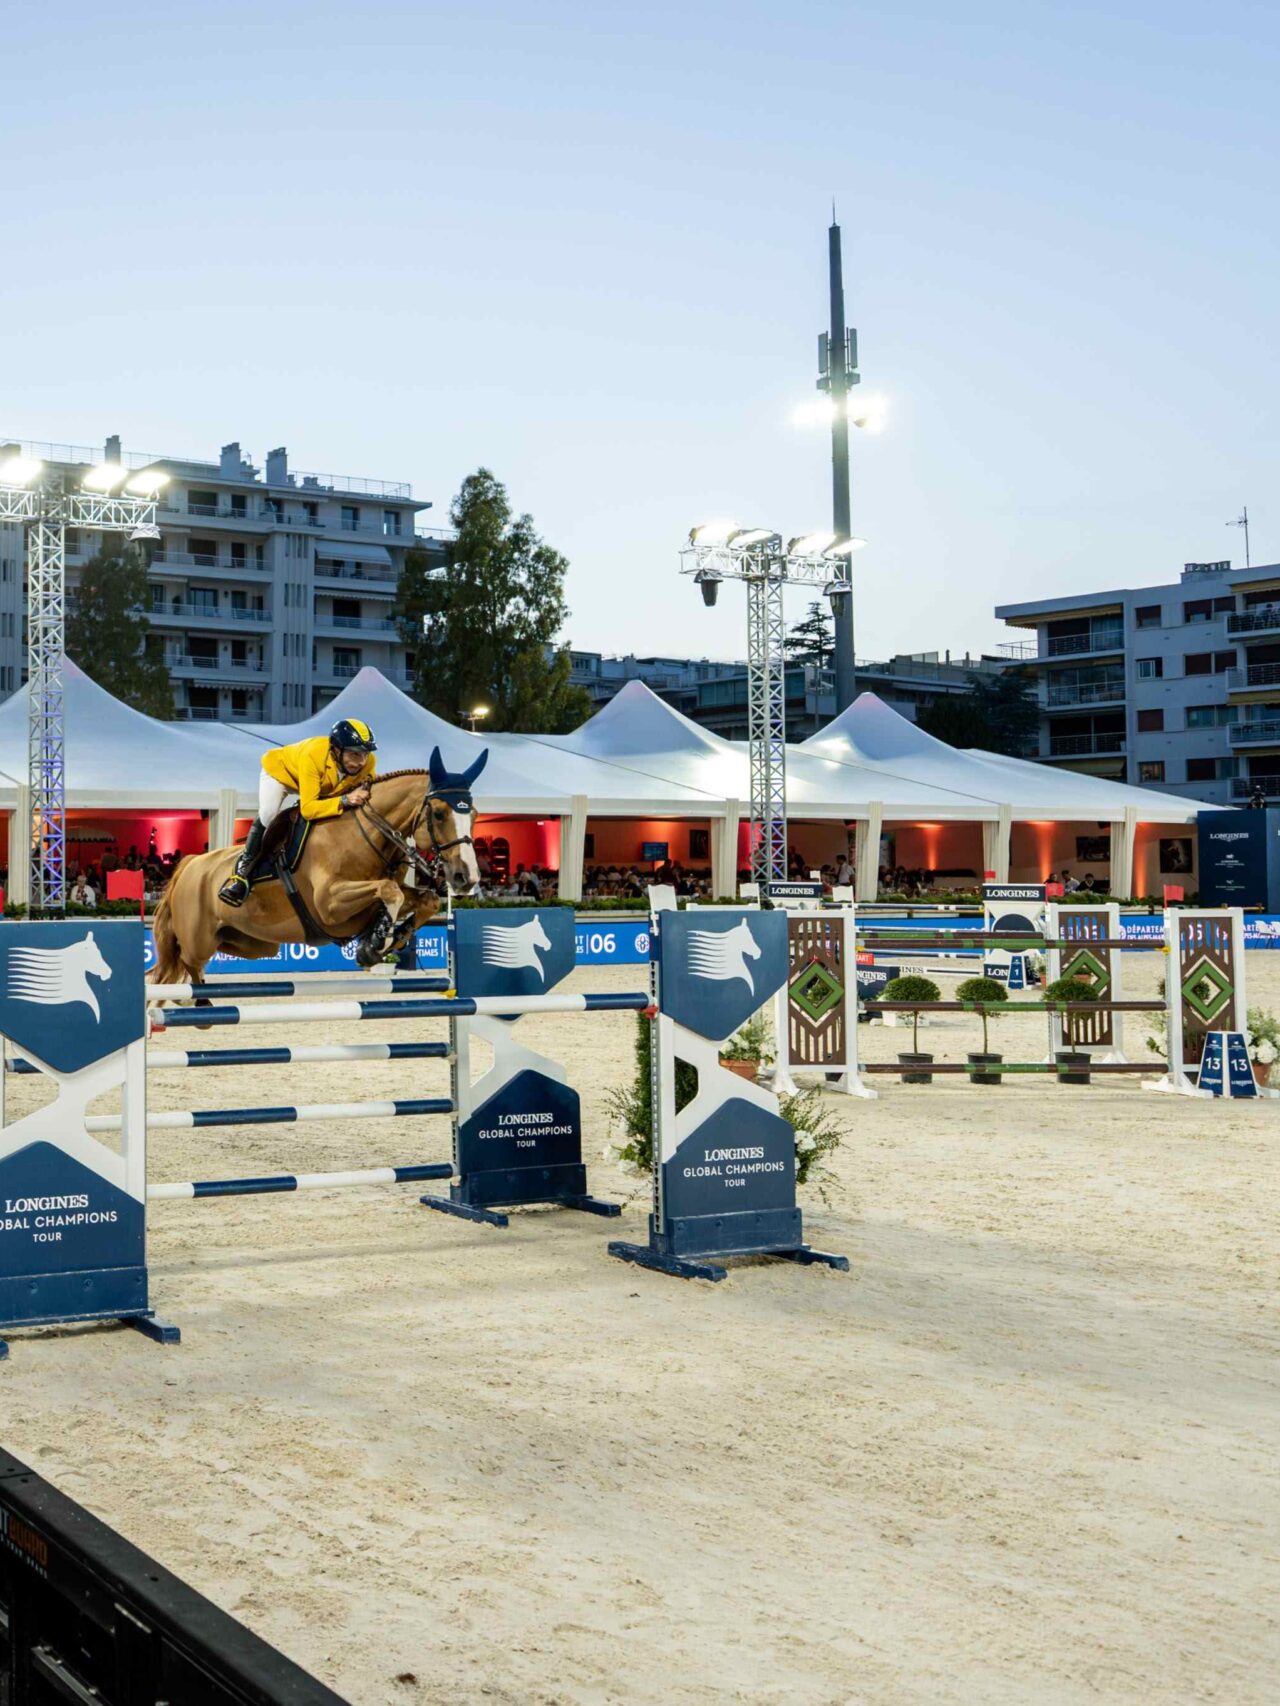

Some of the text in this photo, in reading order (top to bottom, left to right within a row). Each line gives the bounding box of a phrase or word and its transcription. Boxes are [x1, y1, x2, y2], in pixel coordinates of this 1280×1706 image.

[771, 887, 815, 896] LONGINES
[986, 889, 1039, 898] LONGINES
[590, 933, 616, 953] 06
[290, 943, 319, 960] 06
[1205, 1057, 1221, 1070] 13
[1231, 1058, 1248, 1072] 13
[498, 1113, 554, 1125] LONGINES
[479, 1125, 573, 1139] GLOBAL CHAMPIONS
[516, 1140, 536, 1148] TOUR
[704, 1147, 764, 1161] LONGINES
[683, 1161, 785, 1177] GLOBAL CHAMPIONS
[724, 1179, 746, 1187] TOUR
[5, 1194, 89, 1213] LONGINES
[34, 1211, 118, 1228] CHAMPIONS
[33, 1232, 62, 1242] TOUR
